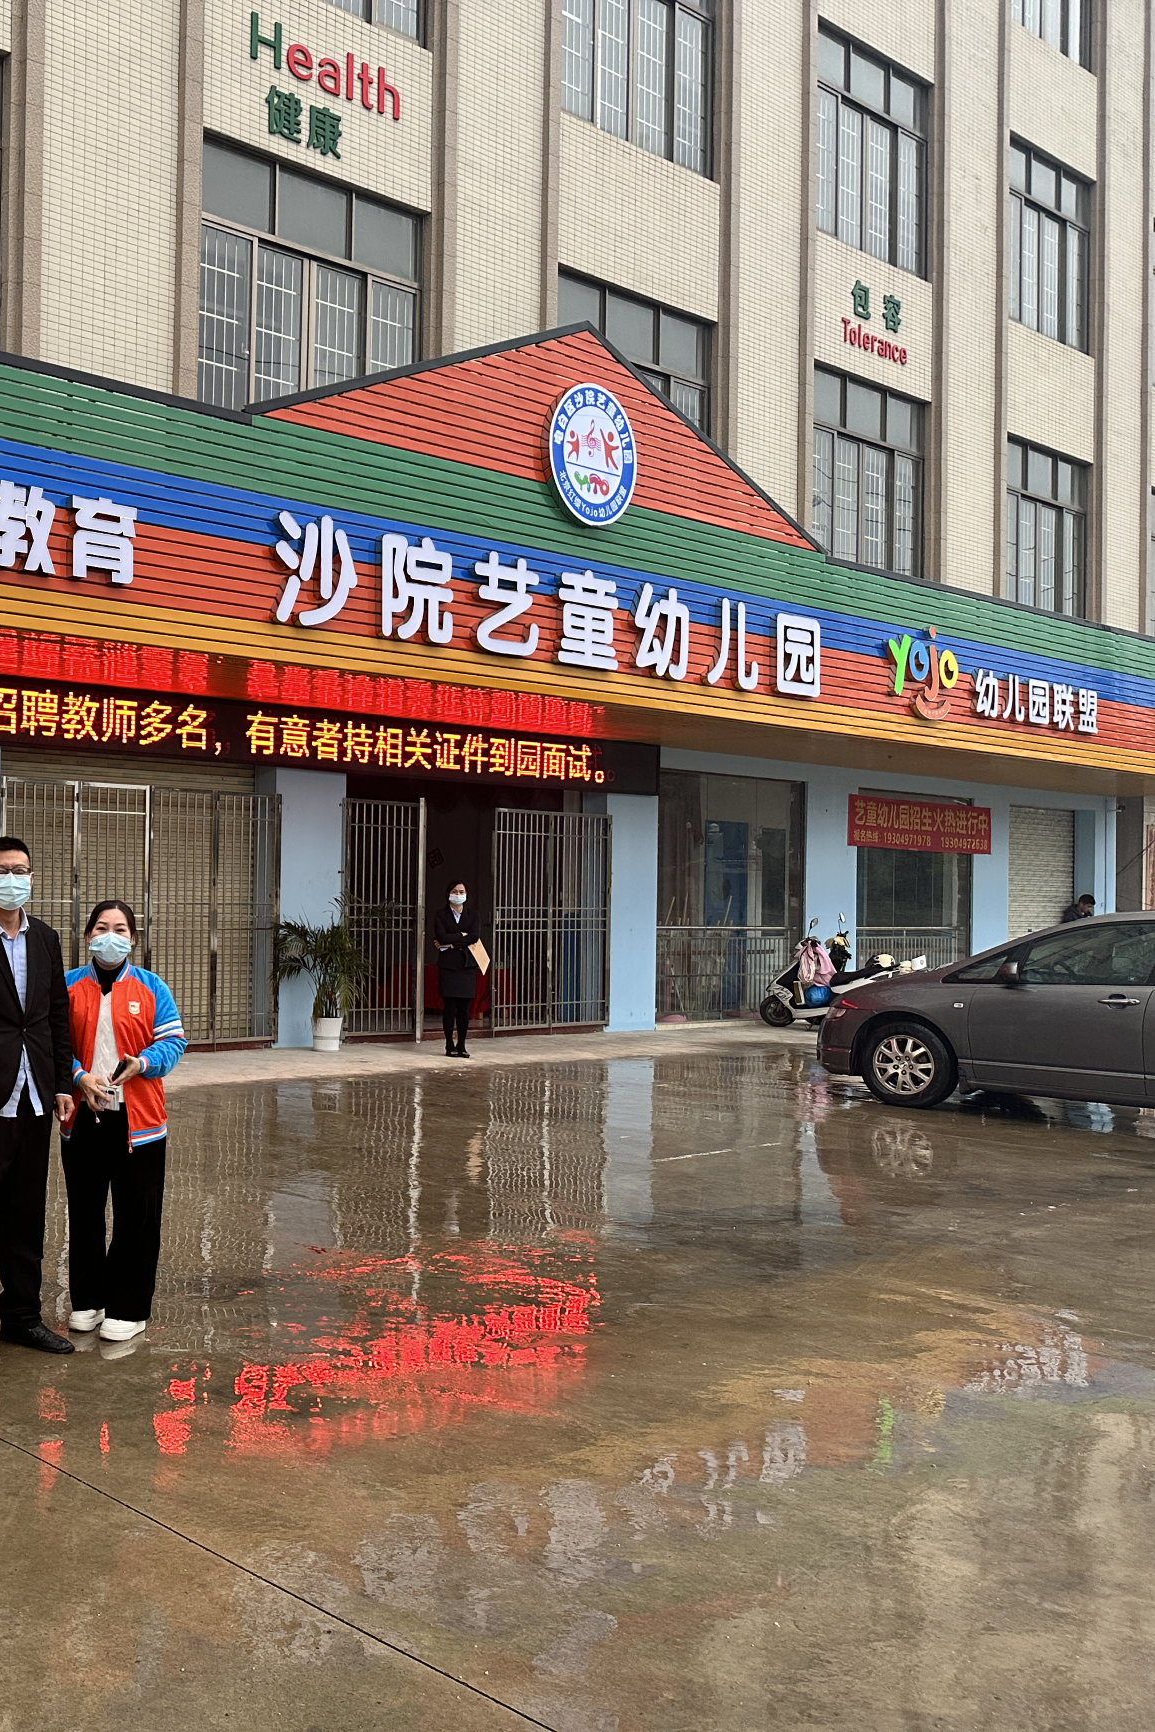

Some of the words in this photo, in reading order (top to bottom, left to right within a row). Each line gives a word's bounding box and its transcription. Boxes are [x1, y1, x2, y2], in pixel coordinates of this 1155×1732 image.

[250, 11, 400, 121] Health
[265, 85, 342, 159] 健康
[851, 280, 902, 333] 包容
[841, 317, 907, 365] Tolerance
[275, 510, 821, 698] 沙院艺童幼儿园
[975, 668, 1099, 734] 幼儿园联盟
[854, 799, 989, 836] 艺童幼儿园招生火热进行中
